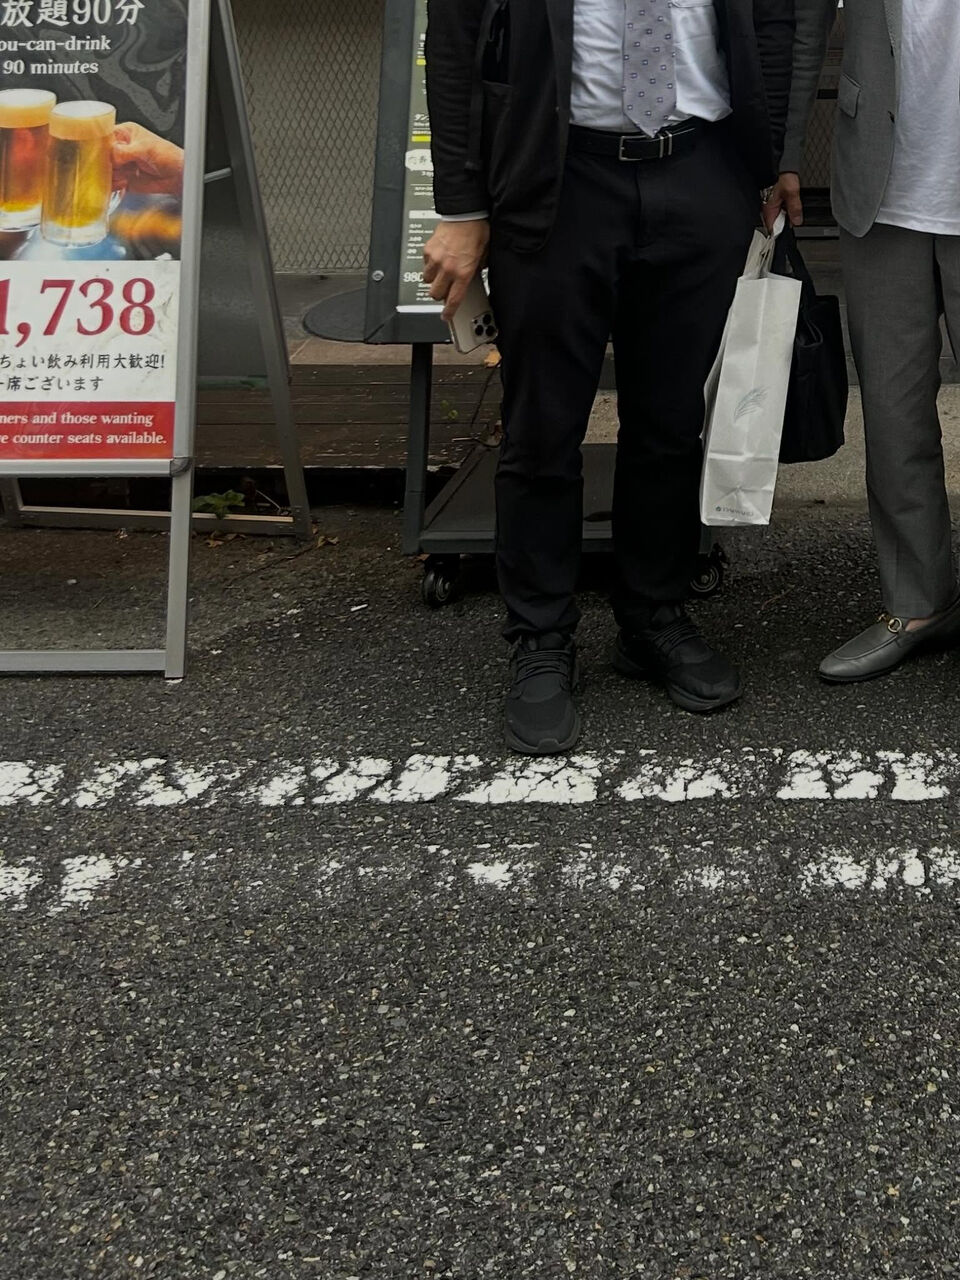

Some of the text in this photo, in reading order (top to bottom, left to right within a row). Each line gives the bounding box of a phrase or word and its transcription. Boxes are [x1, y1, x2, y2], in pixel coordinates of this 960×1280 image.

[2, 58, 100, 75] 90 minutes
[0, 376, 104, 391] 席ございます
[31, 412, 57, 424] and
[60, 411, 98, 424] those
[101, 411, 154, 426] wanting
[12, 433, 64, 444] counter
[67, 433, 103, 444] seats
[106, 431, 167, 444] available.
